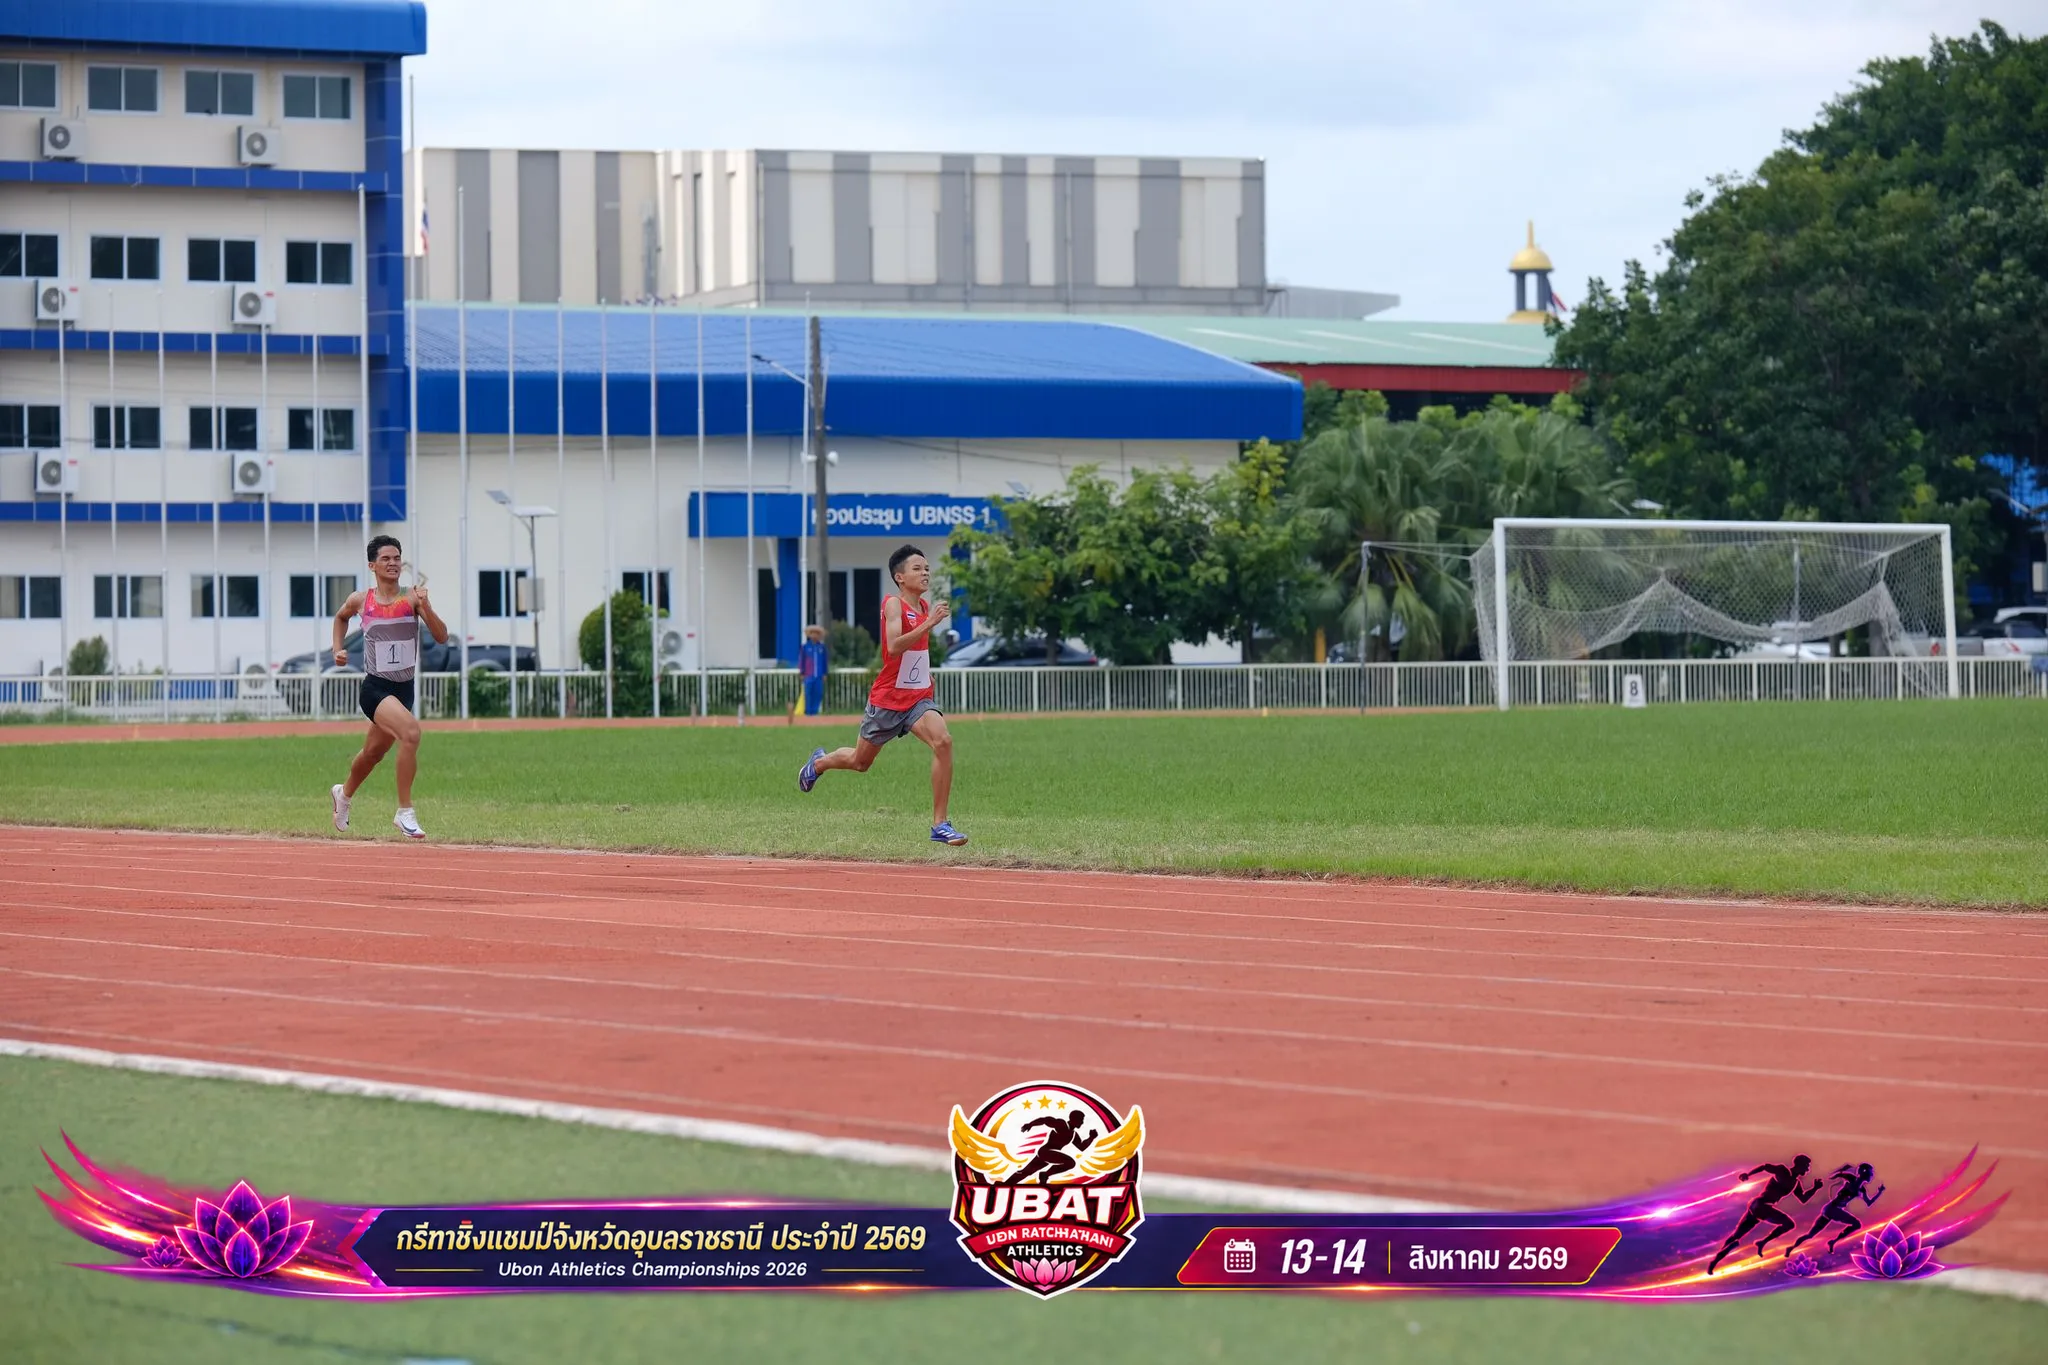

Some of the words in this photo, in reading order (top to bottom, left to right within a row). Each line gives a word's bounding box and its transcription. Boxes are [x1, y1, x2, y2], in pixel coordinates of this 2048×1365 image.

[909, 506, 976, 525] UBNSS
[981, 507, 990, 525] 1
[387, 643, 401, 665] 1
[908, 655, 922, 682] 6
[1630, 680, 1639, 697] 8
